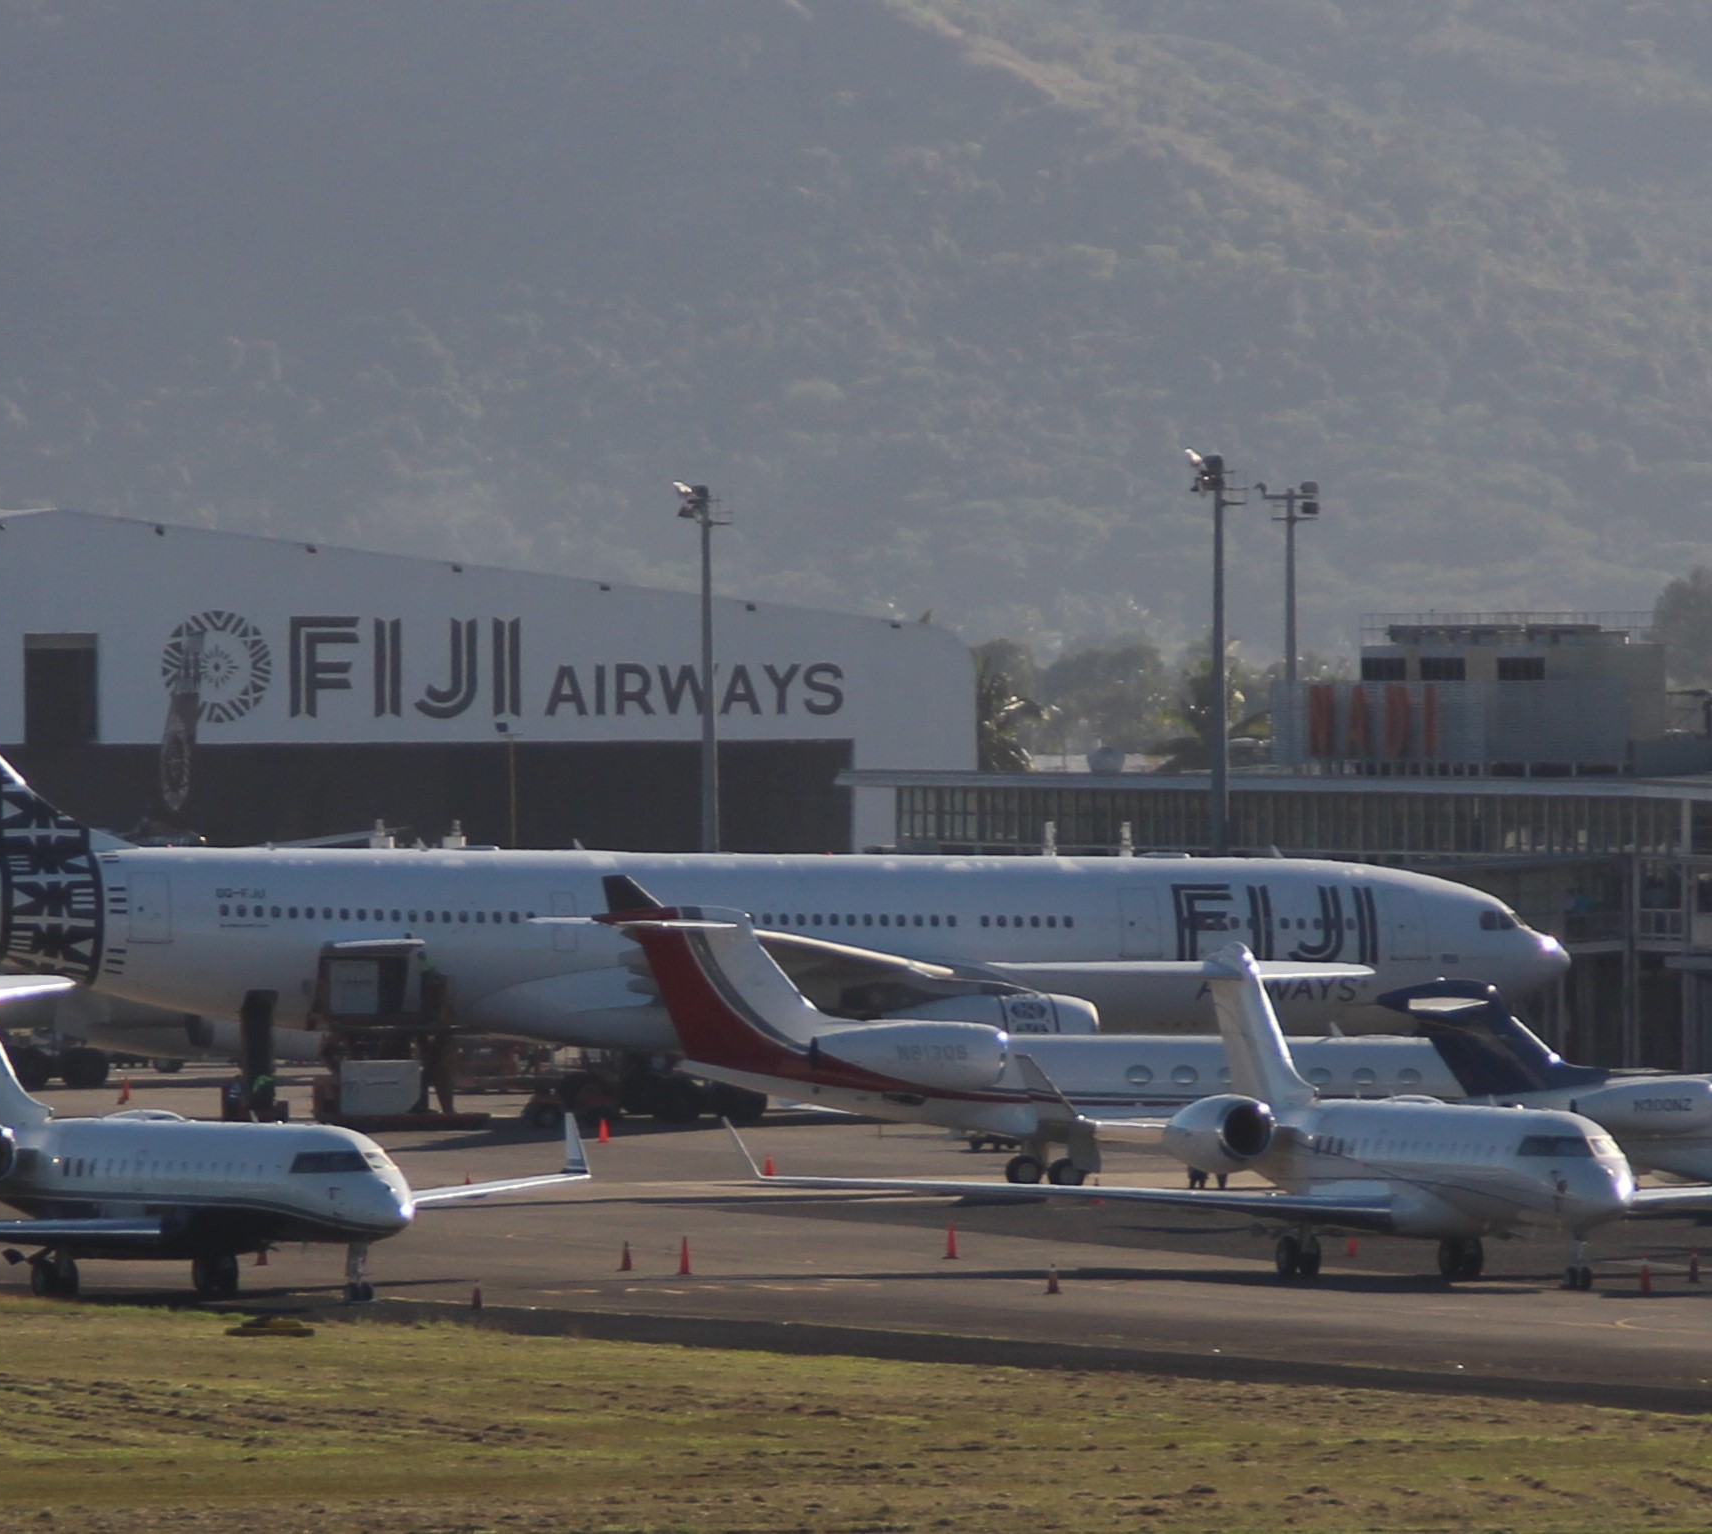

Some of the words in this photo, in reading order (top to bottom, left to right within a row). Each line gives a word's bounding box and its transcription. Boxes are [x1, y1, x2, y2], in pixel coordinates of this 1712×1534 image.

[289, 616, 522, 719] FIJI
[543, 662, 844, 717] AIRWAYS
[1307, 683, 1438, 758] NADI
[1170, 883, 1380, 964] FIJI
[1195, 977, 1357, 1001] AWAYS
